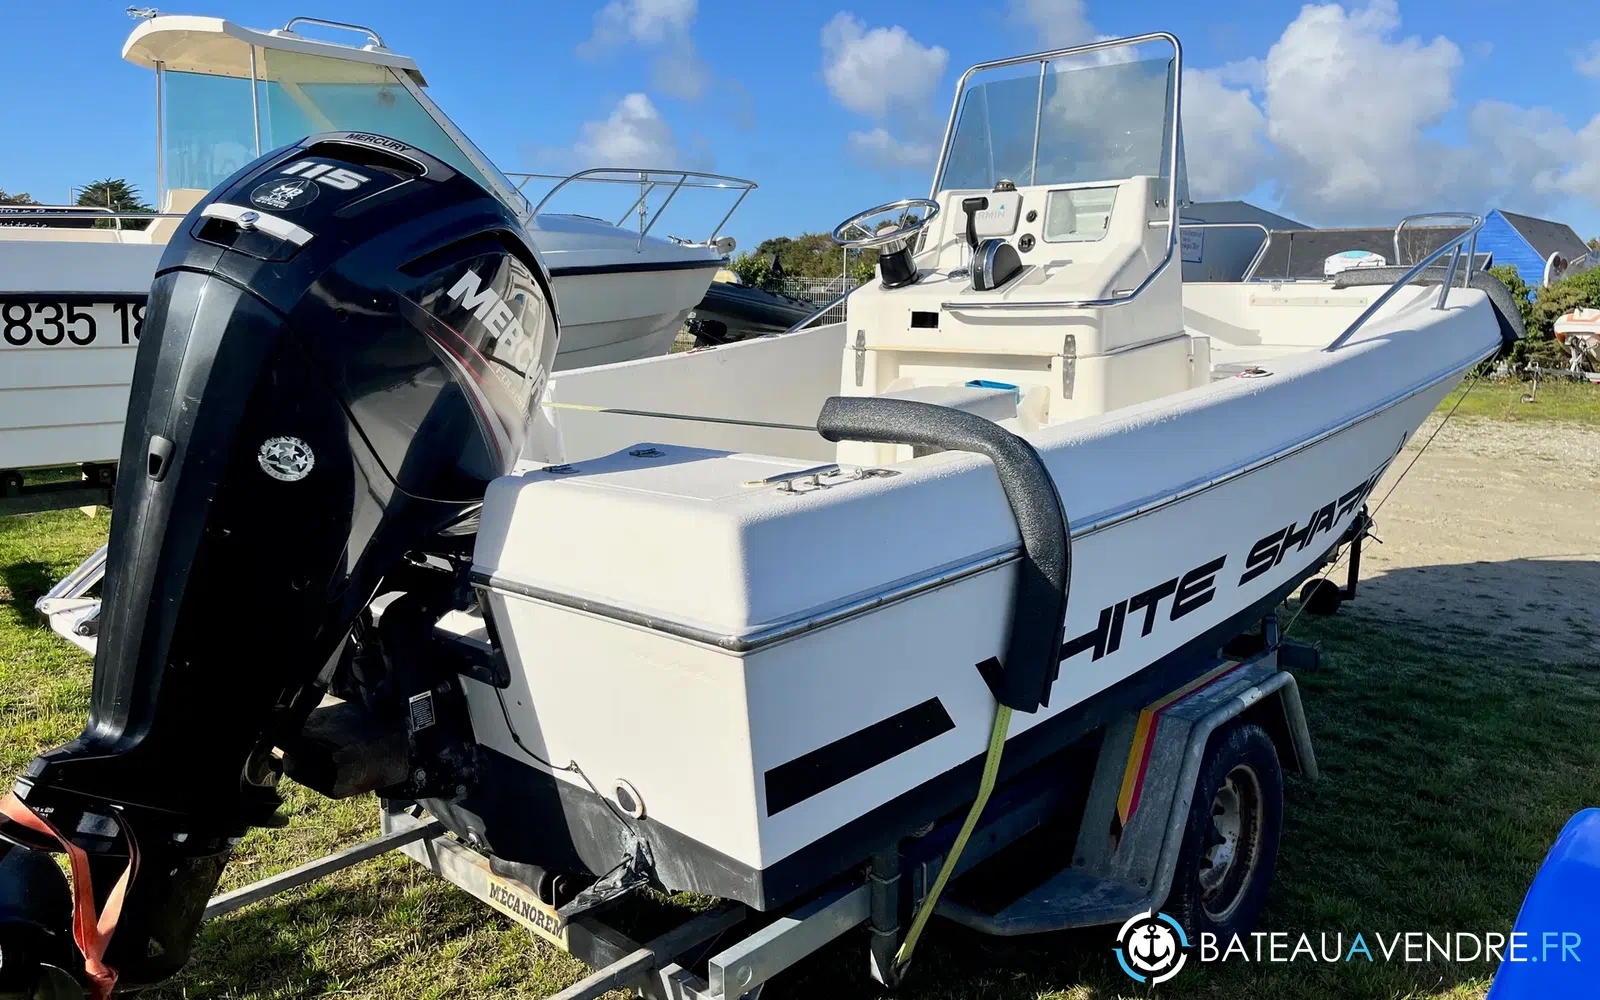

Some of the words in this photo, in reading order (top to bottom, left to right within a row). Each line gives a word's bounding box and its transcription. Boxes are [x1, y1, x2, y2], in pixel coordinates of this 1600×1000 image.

[346, 133, 412, 152] MERCURY
[280, 161, 371, 191] 115
[974, 210, 1006, 220] RMIN
[2, 301, 97, 346] 835
[446, 269, 549, 405] MERCUR
[975, 554, 1227, 702] HITE
